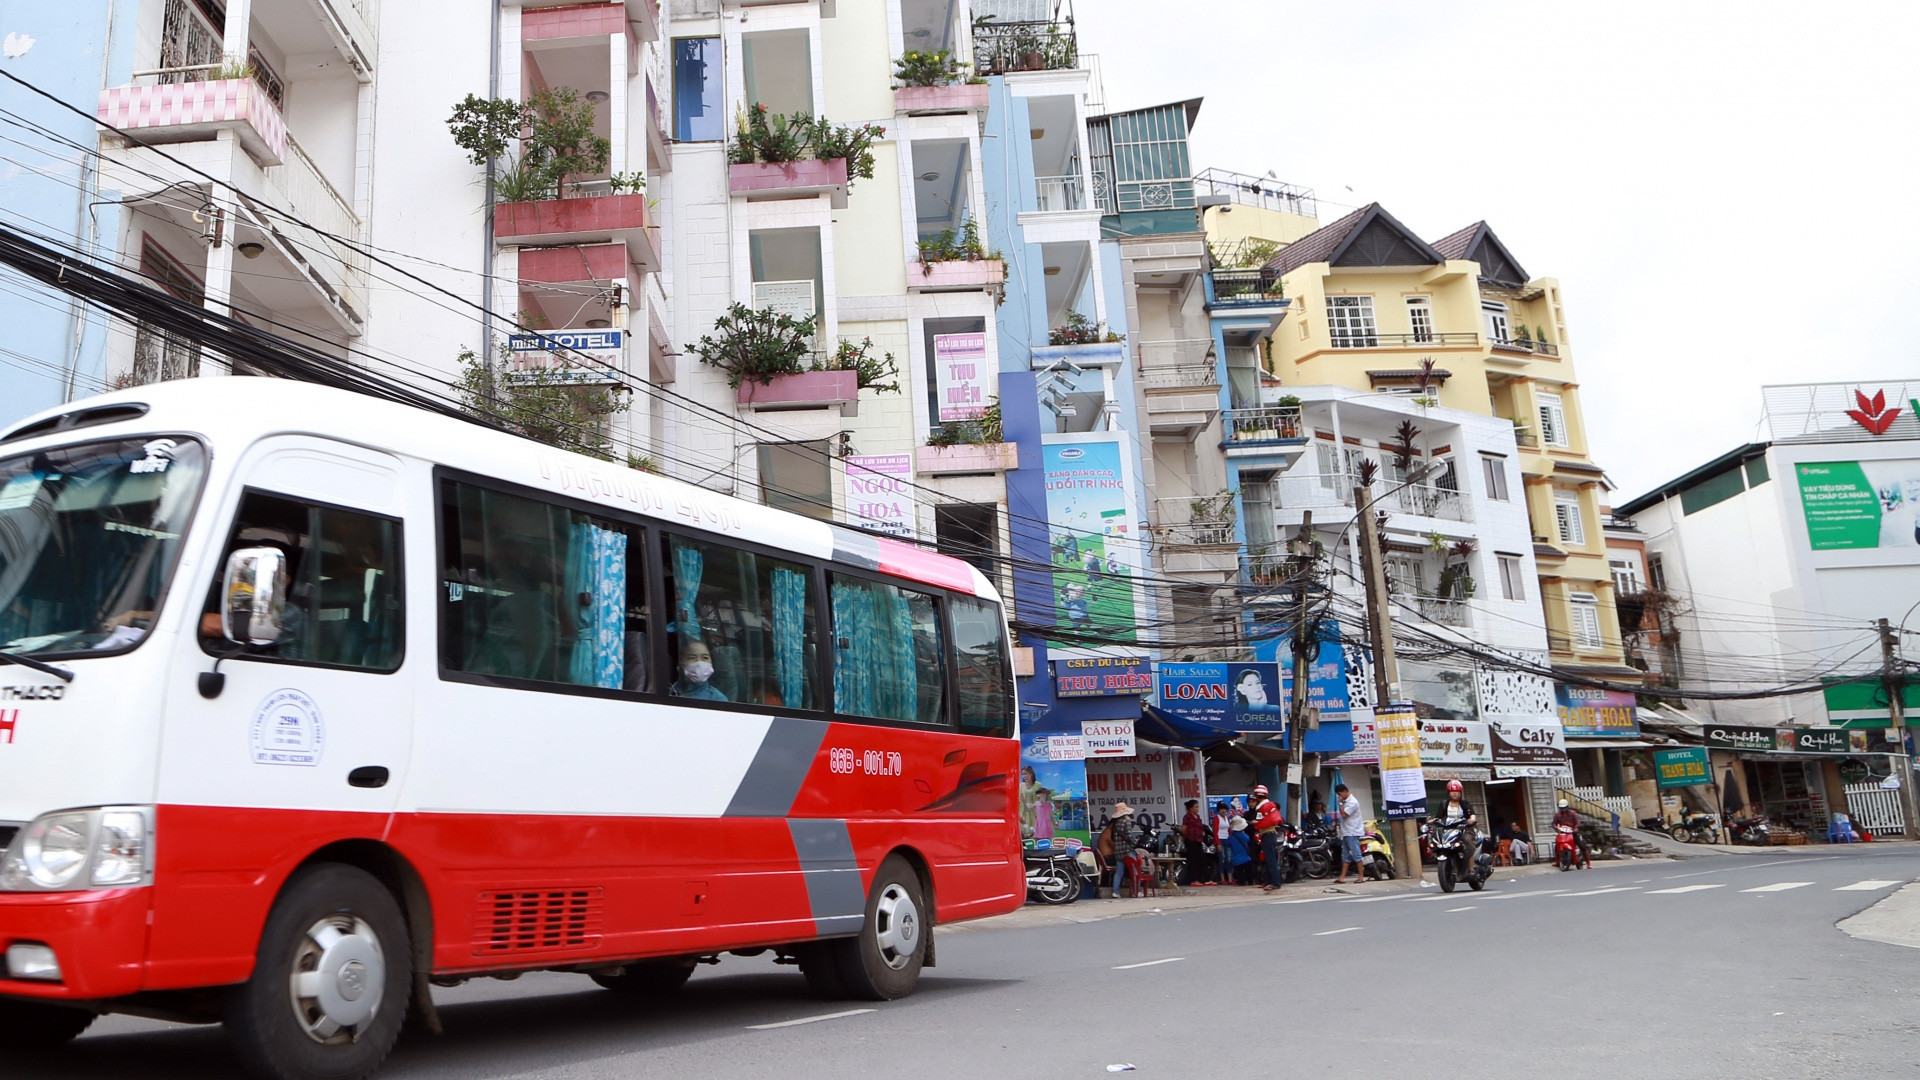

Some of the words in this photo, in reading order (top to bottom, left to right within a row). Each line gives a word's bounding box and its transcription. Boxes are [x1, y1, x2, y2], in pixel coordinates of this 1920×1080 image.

[544, 333, 615, 348] HOTEL
[948, 363, 976, 380] THU
[850, 477, 908, 496] NGỌC
[858, 502, 904, 519] HOA
[1067, 659, 1095, 668] CSLT
[1097, 659, 1112, 667] DU
[1058, 675, 1098, 690] THU
[2, 685, 65, 700] THACO
[1163, 683, 1228, 700] LOAN
[1568, 688, 1608, 700] HOTEL
[1519, 727, 1555, 746] Caly
[830, 747, 854, 774] 86B
[863, 749, 902, 776] 001.70
[1177, 752, 1196, 772] CHO
[1667, 751, 1694, 760] HOTEL
[1087, 773, 1109, 792] HU
